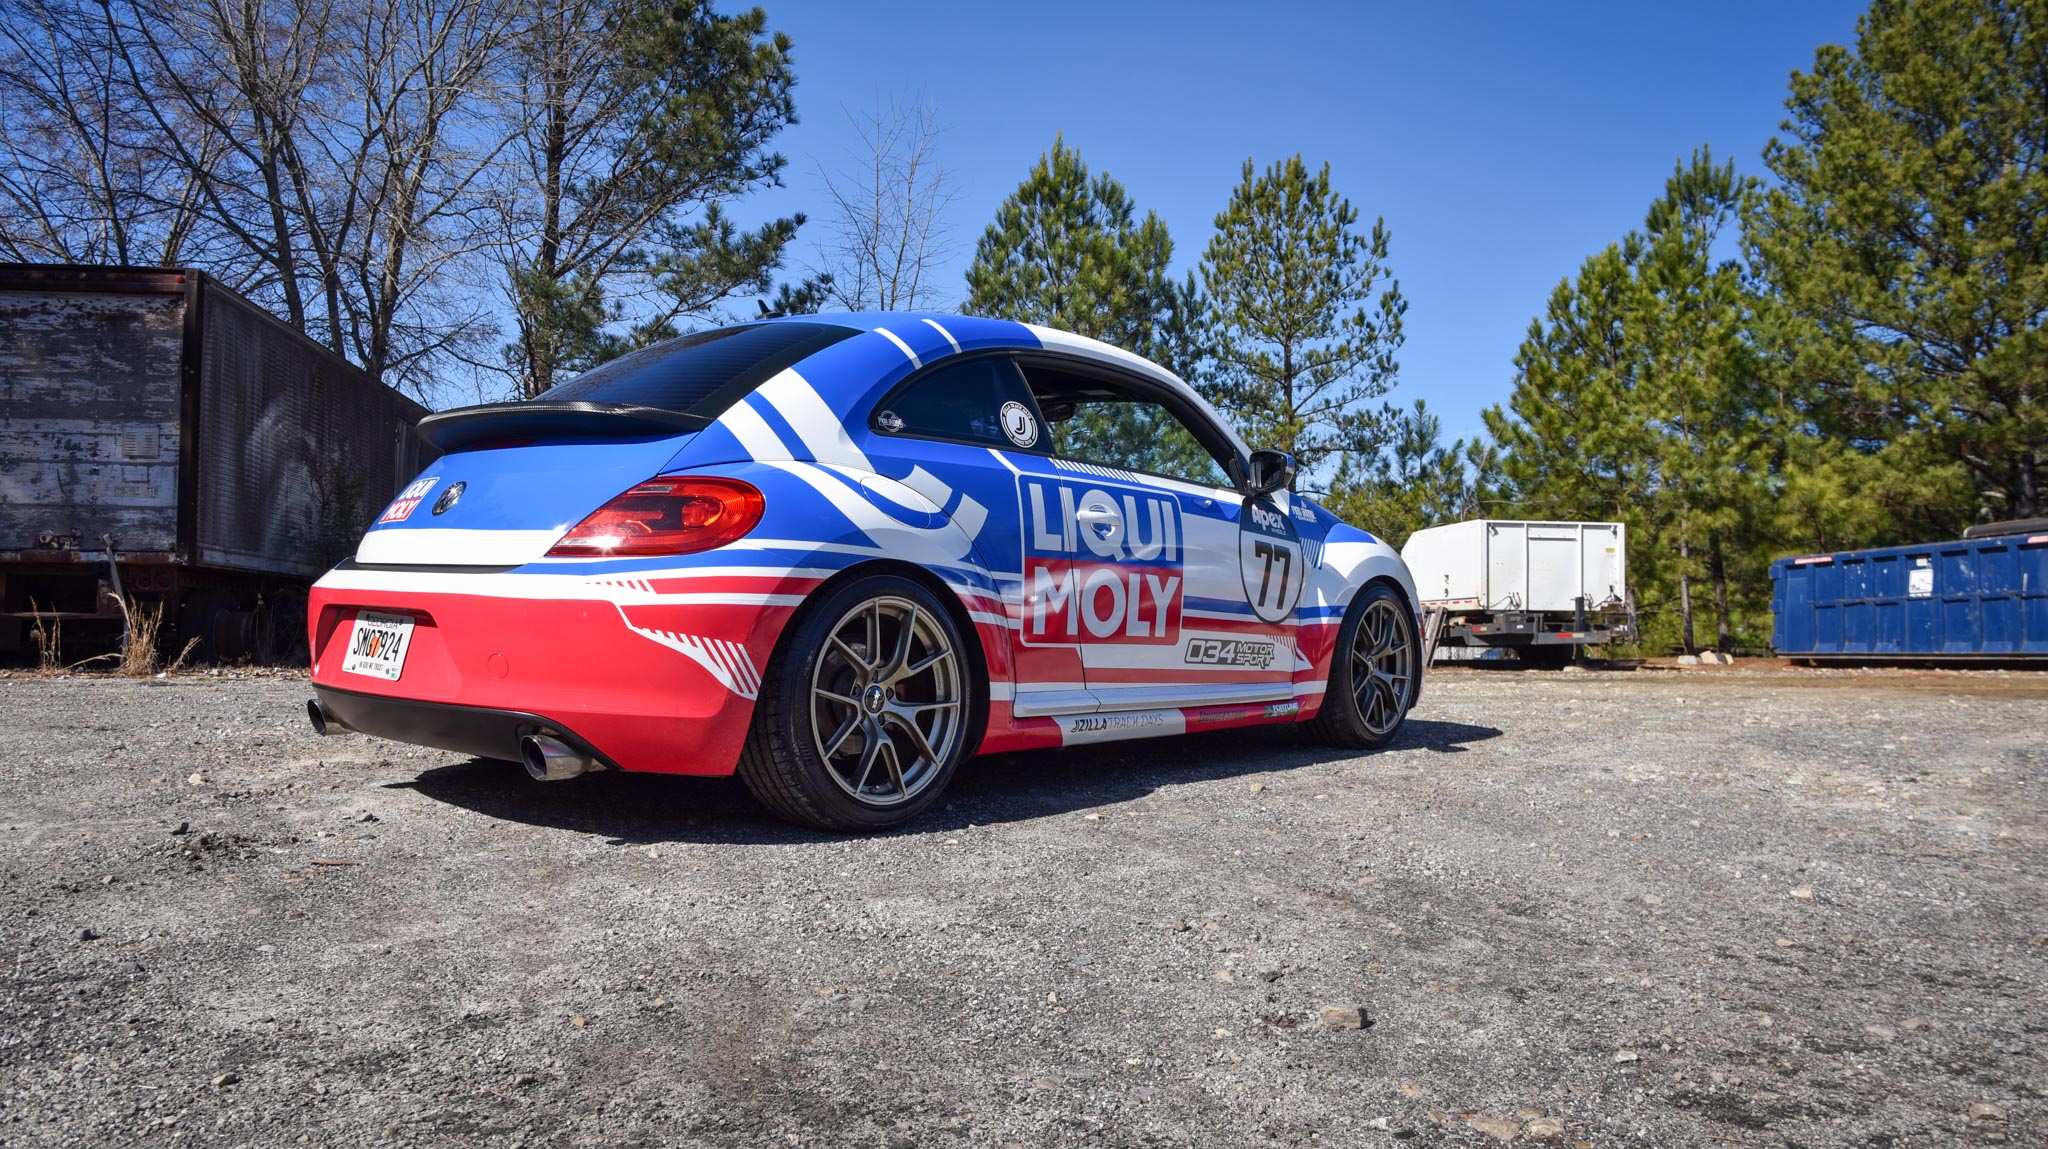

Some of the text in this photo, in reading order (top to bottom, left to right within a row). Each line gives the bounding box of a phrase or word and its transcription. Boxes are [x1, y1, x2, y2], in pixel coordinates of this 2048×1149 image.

[381, 500, 421, 520] MOLY
[1028, 483, 1177, 562] LIQUI
[1254, 540, 1291, 610] 77
[1032, 567, 1181, 638] MOLY
[353, 628, 403, 662] SMG7924
[1186, 639, 1274, 664] 034 MOTOR
[1235, 653, 1274, 669] SPORT
[1140, 713, 1165, 727] DAYS
